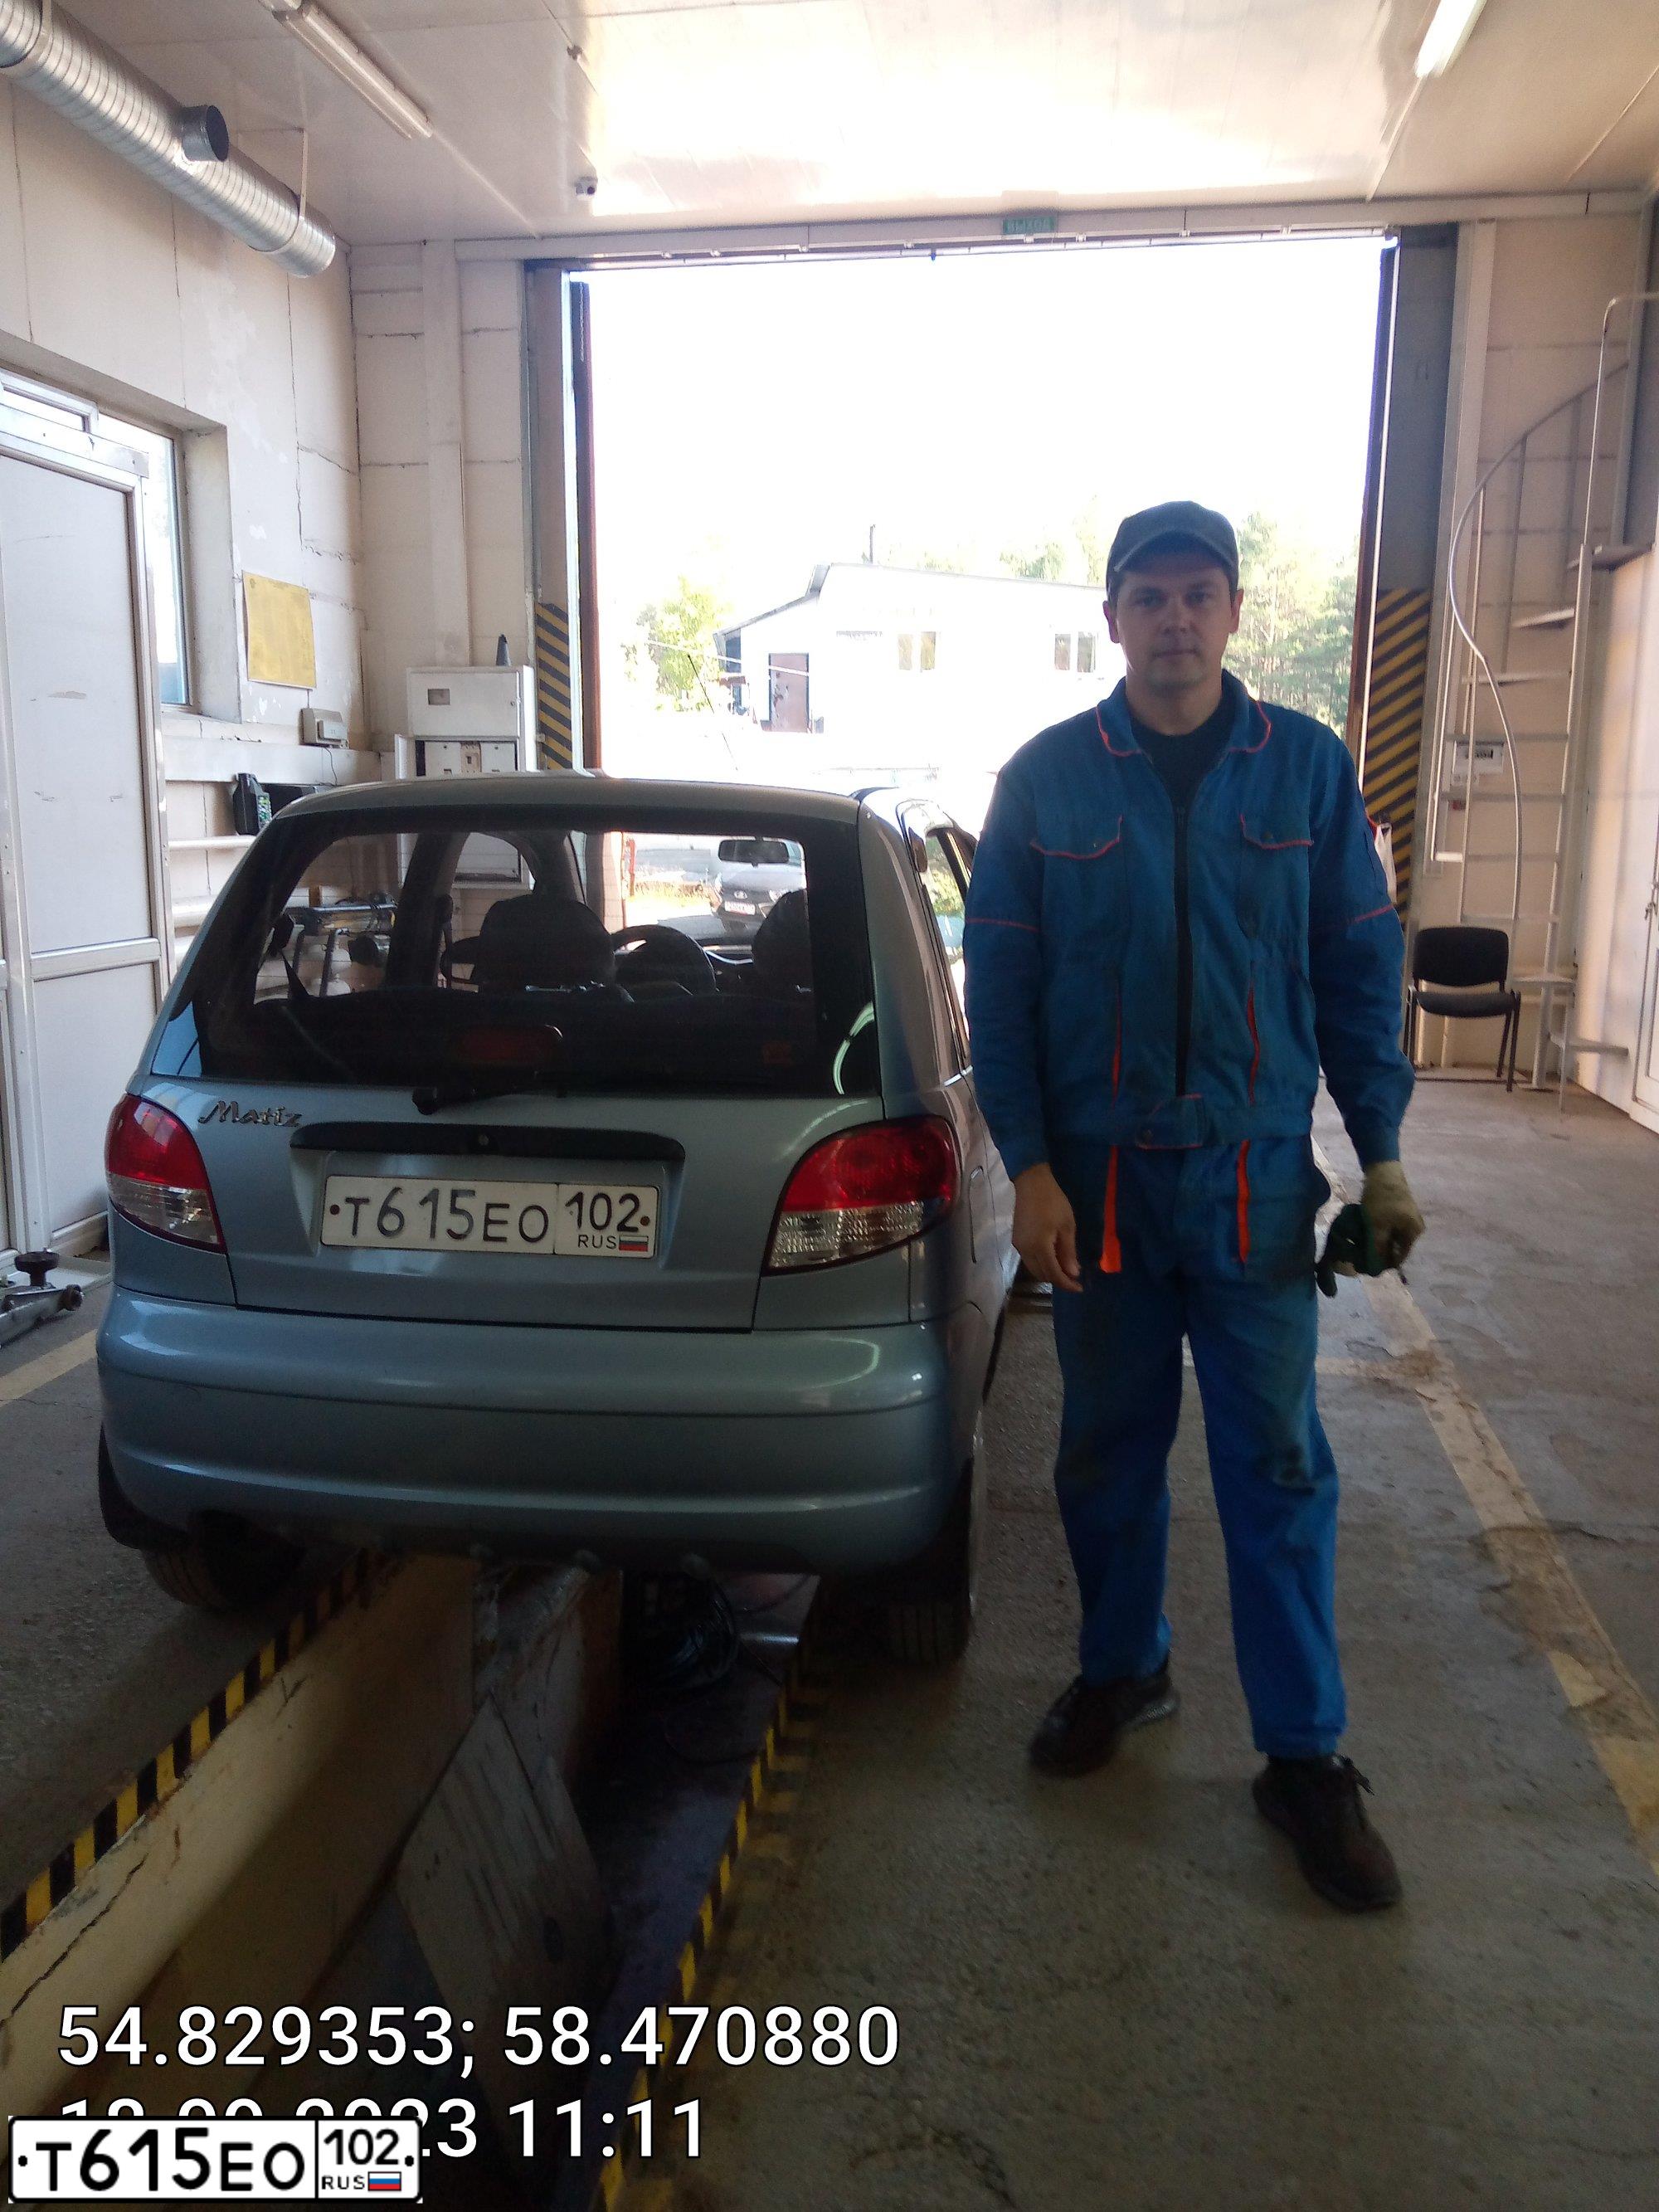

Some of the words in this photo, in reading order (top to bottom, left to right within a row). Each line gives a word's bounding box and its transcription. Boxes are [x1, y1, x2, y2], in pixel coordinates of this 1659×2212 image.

[197, 1100, 302, 1127] Matiz
[565, 1191, 641, 1235] 102
[577, 1234, 617, 1250] RUS
